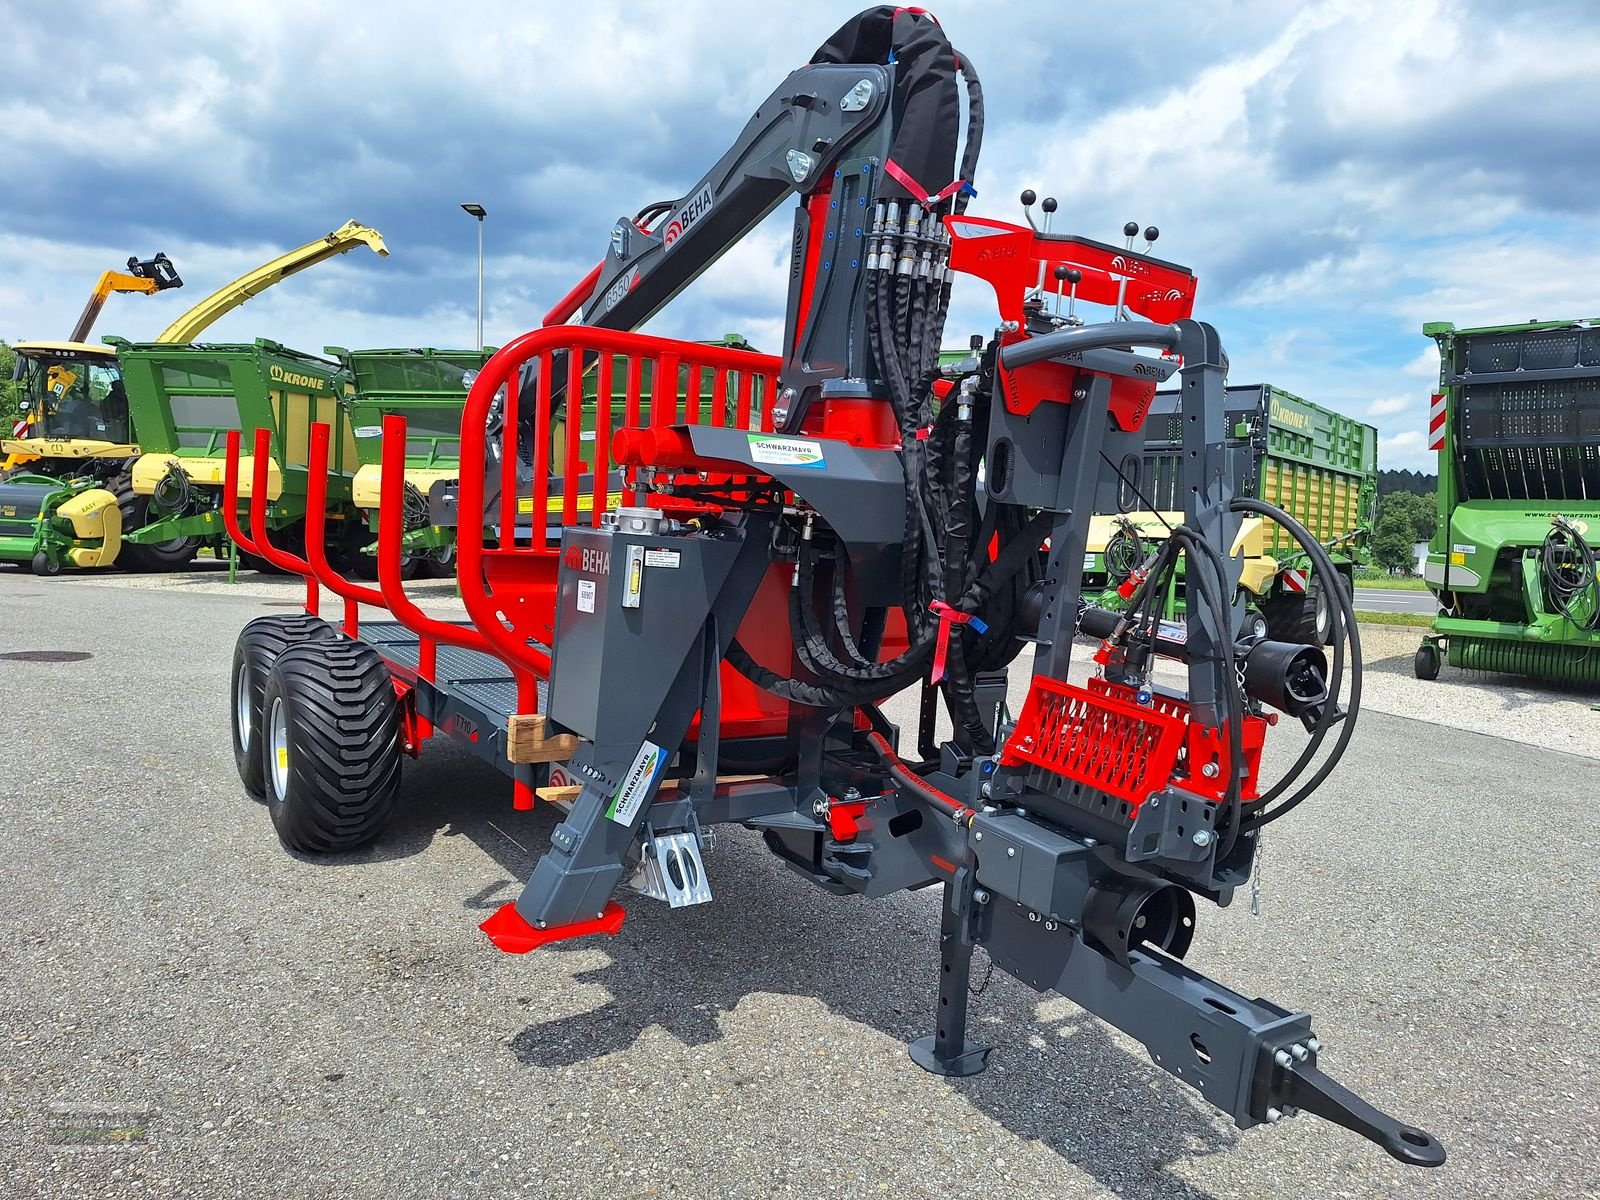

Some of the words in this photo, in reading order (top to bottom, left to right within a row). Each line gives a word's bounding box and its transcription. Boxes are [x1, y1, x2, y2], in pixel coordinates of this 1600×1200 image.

[681, 189, 711, 230] BEHA
[793, 246, 802, 279] BEHA
[606, 274, 630, 308] 6550
[283, 371, 325, 390] KRONE
[1146, 365, 1166, 379] BEHA
[1279, 407, 1304, 429] KRONE
[756, 441, 812, 453] SCHWARZMAYR
[81, 501, 97, 513] EASY
[582, 548, 611, 576] BEHA
[456, 714, 472, 734] T710
[616, 754, 650, 814] SCHWARZMAYR
